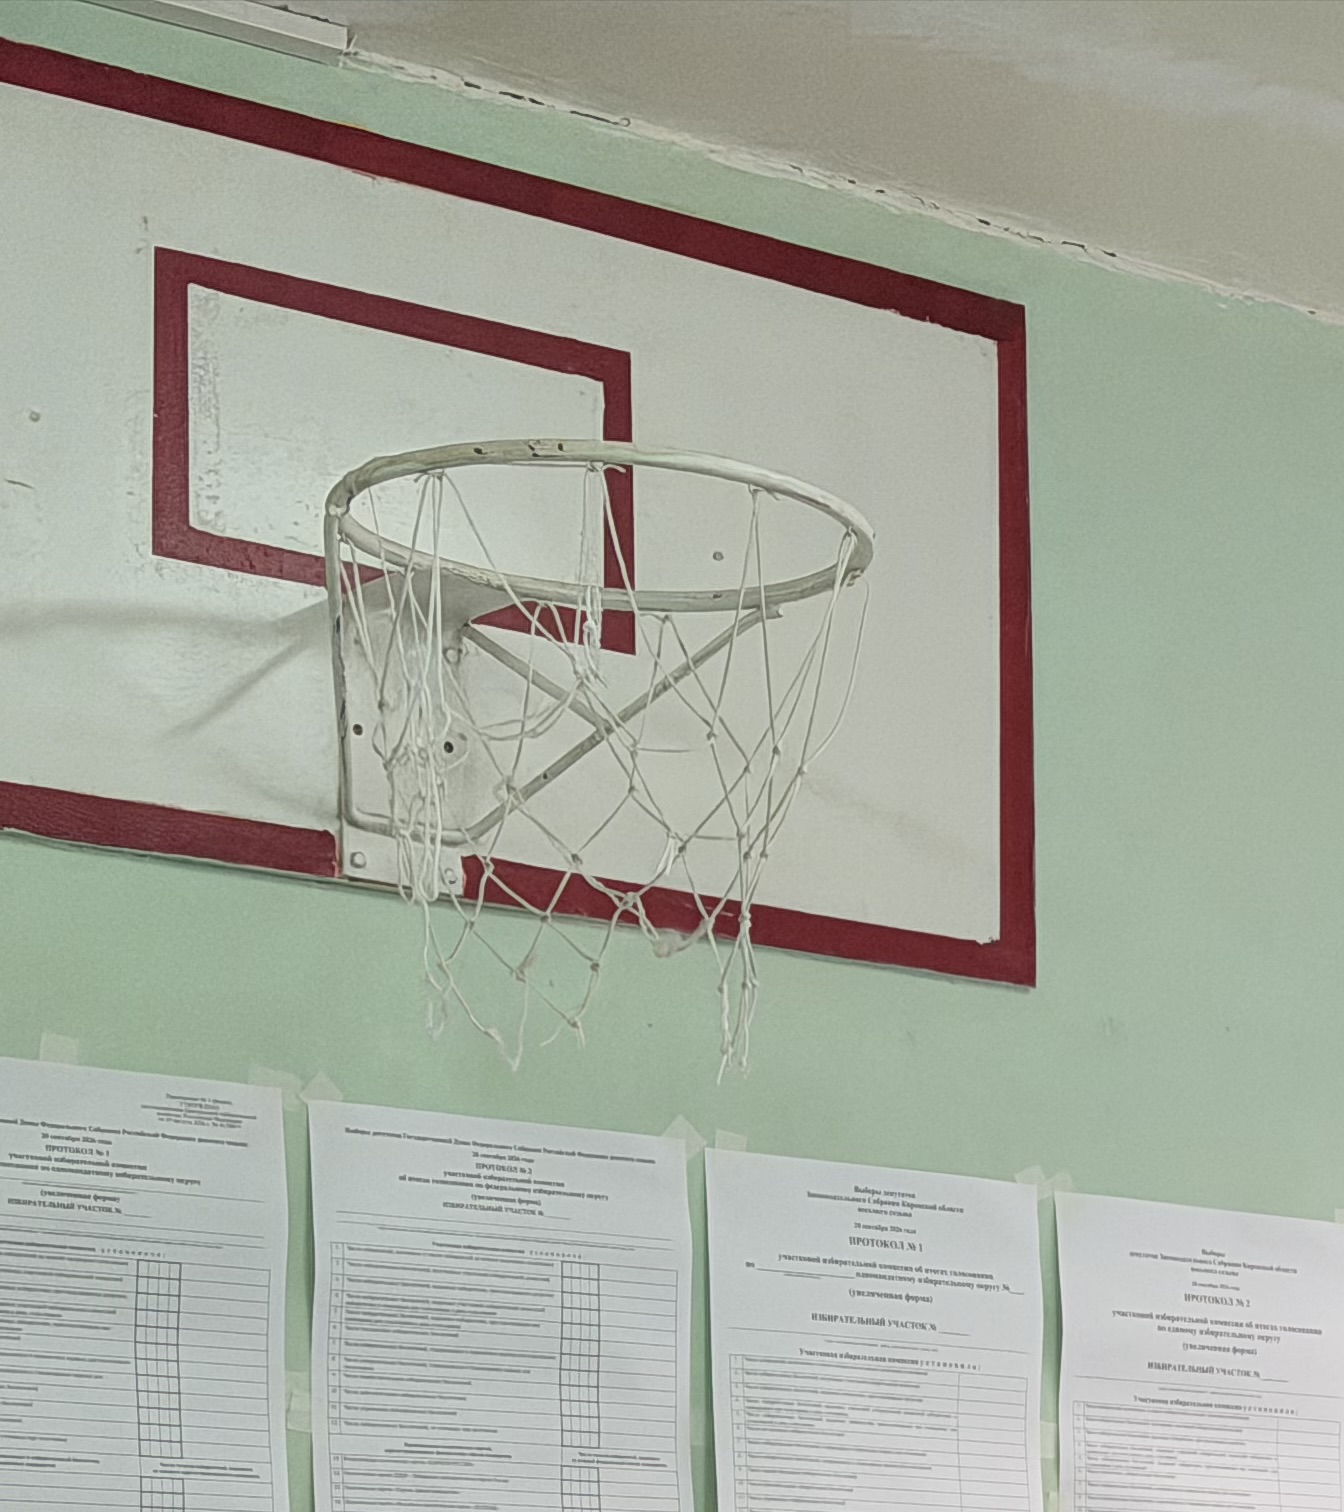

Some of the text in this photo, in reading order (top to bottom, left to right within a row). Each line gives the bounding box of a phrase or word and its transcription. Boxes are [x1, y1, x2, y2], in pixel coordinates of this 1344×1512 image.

[849, 1236, 904, 1250] ПРОТОКОЛ
[1184, 1293, 1234, 1306] ПРОТОКОЛ
[812, 1312, 886, 1326] ИЗБИРАТЕЛЬНЫЙ
[888, 1319, 928, 1330] УЧАСТОК
[1148, 1361, 1214, 1374] ИЗБИРАТЕЛЬНЫЙ
